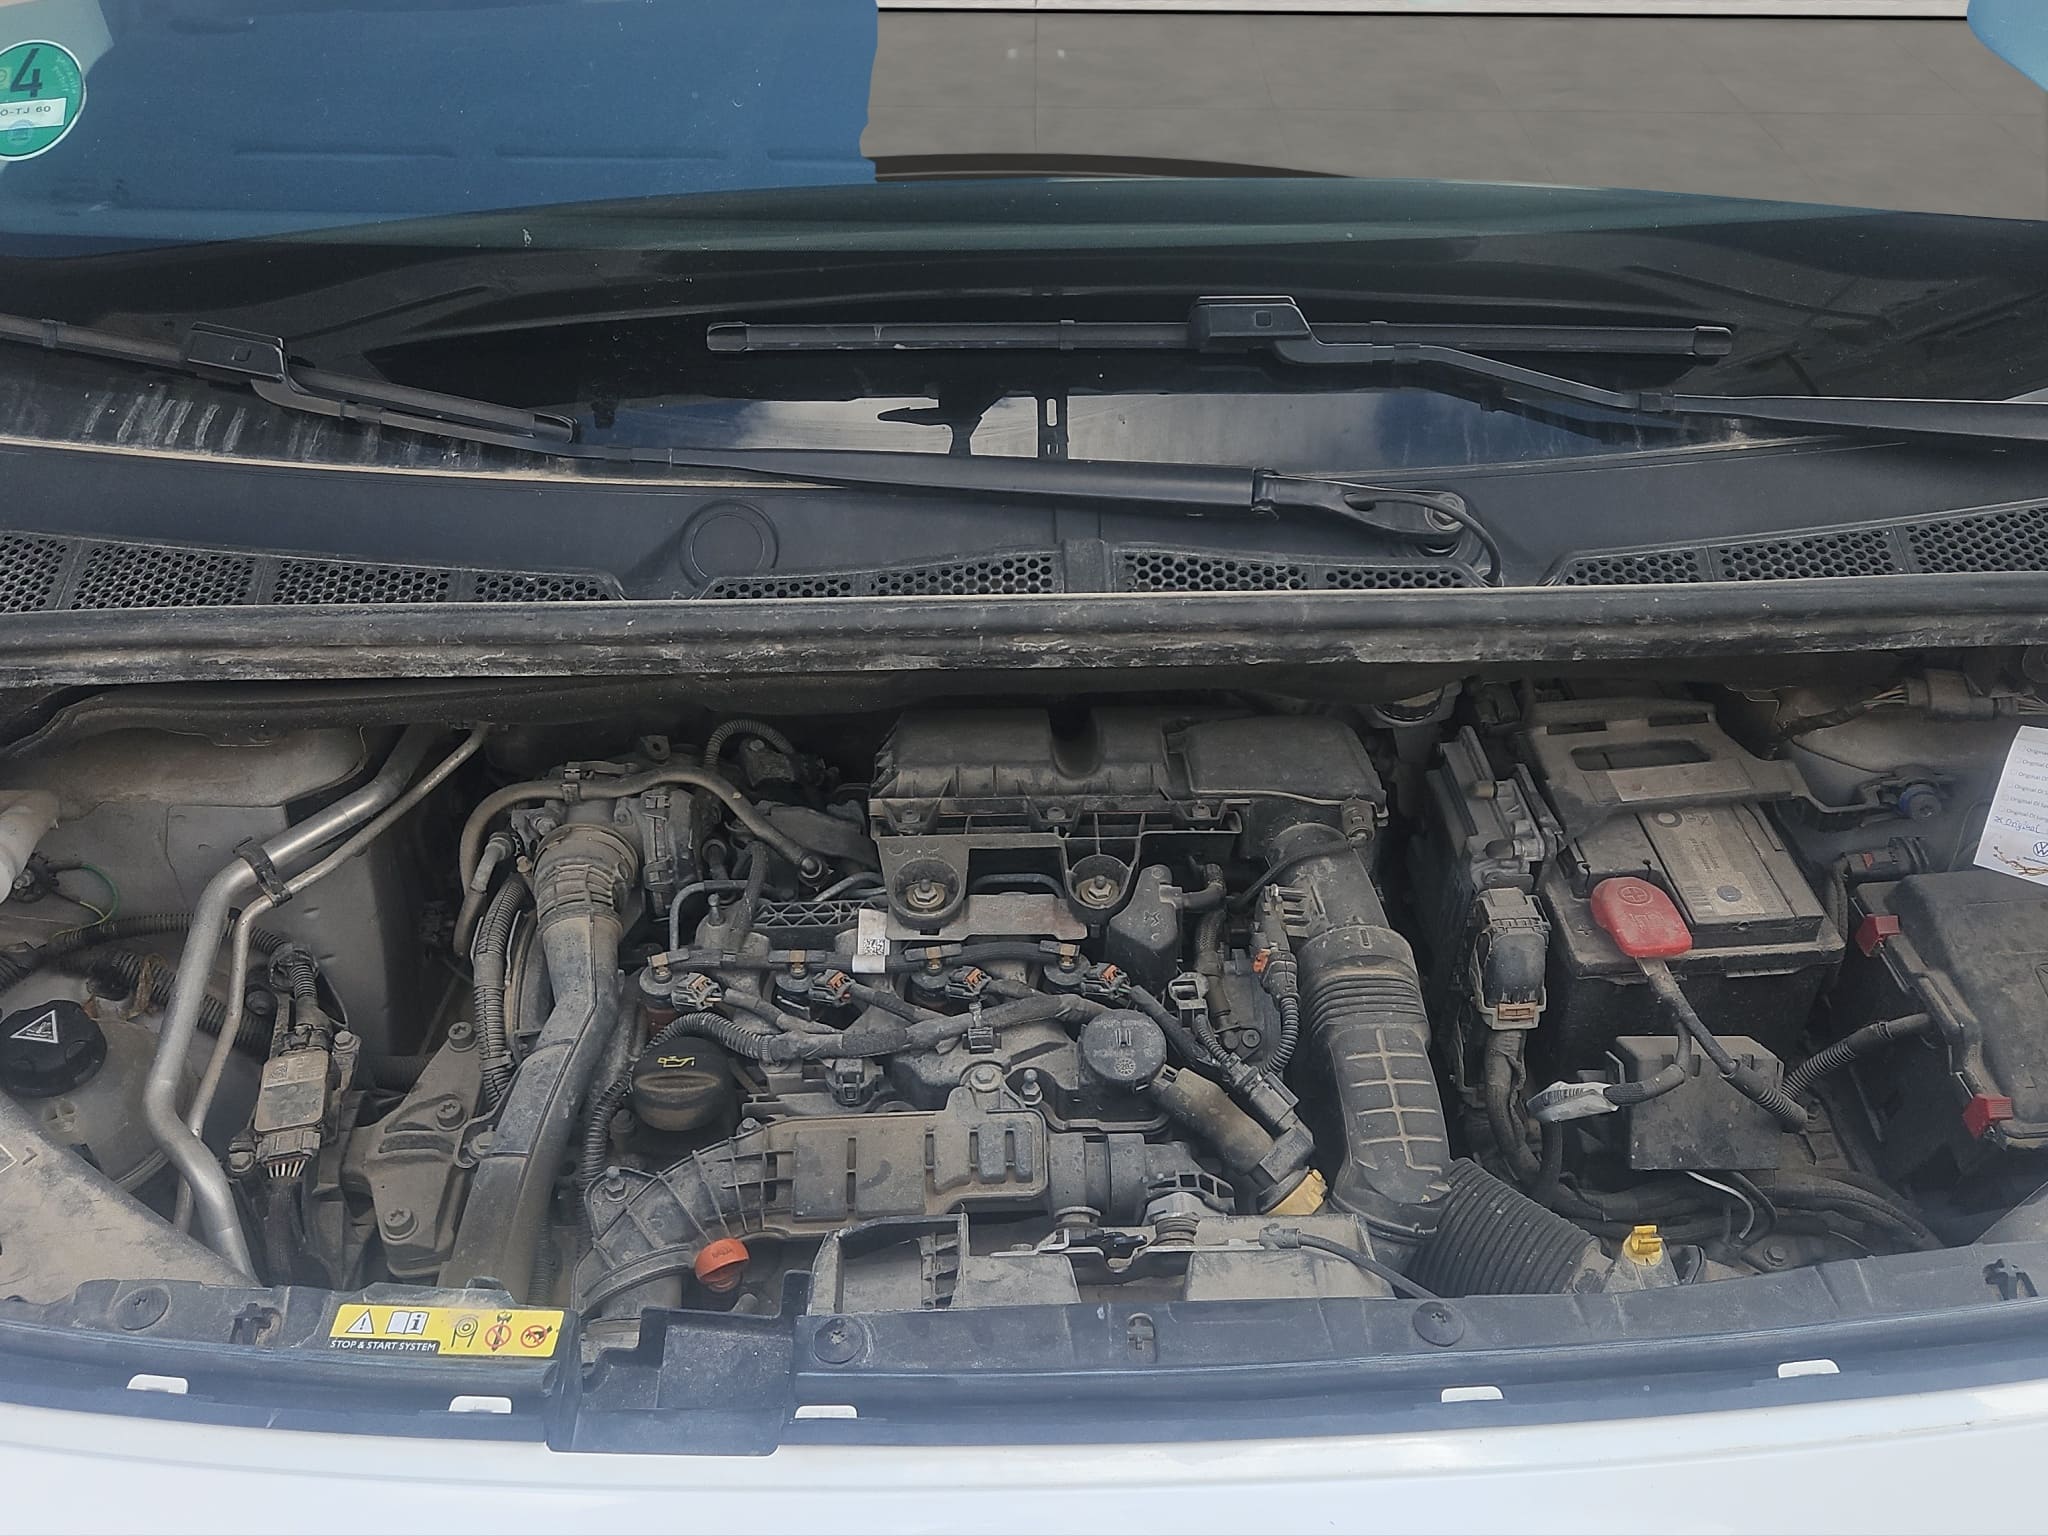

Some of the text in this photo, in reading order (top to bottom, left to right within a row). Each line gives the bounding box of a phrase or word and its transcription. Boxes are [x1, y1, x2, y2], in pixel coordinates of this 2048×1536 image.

[10, 48, 42, 97] 4
[330, 1340, 437, 1352] STOP & START SYSTEM
